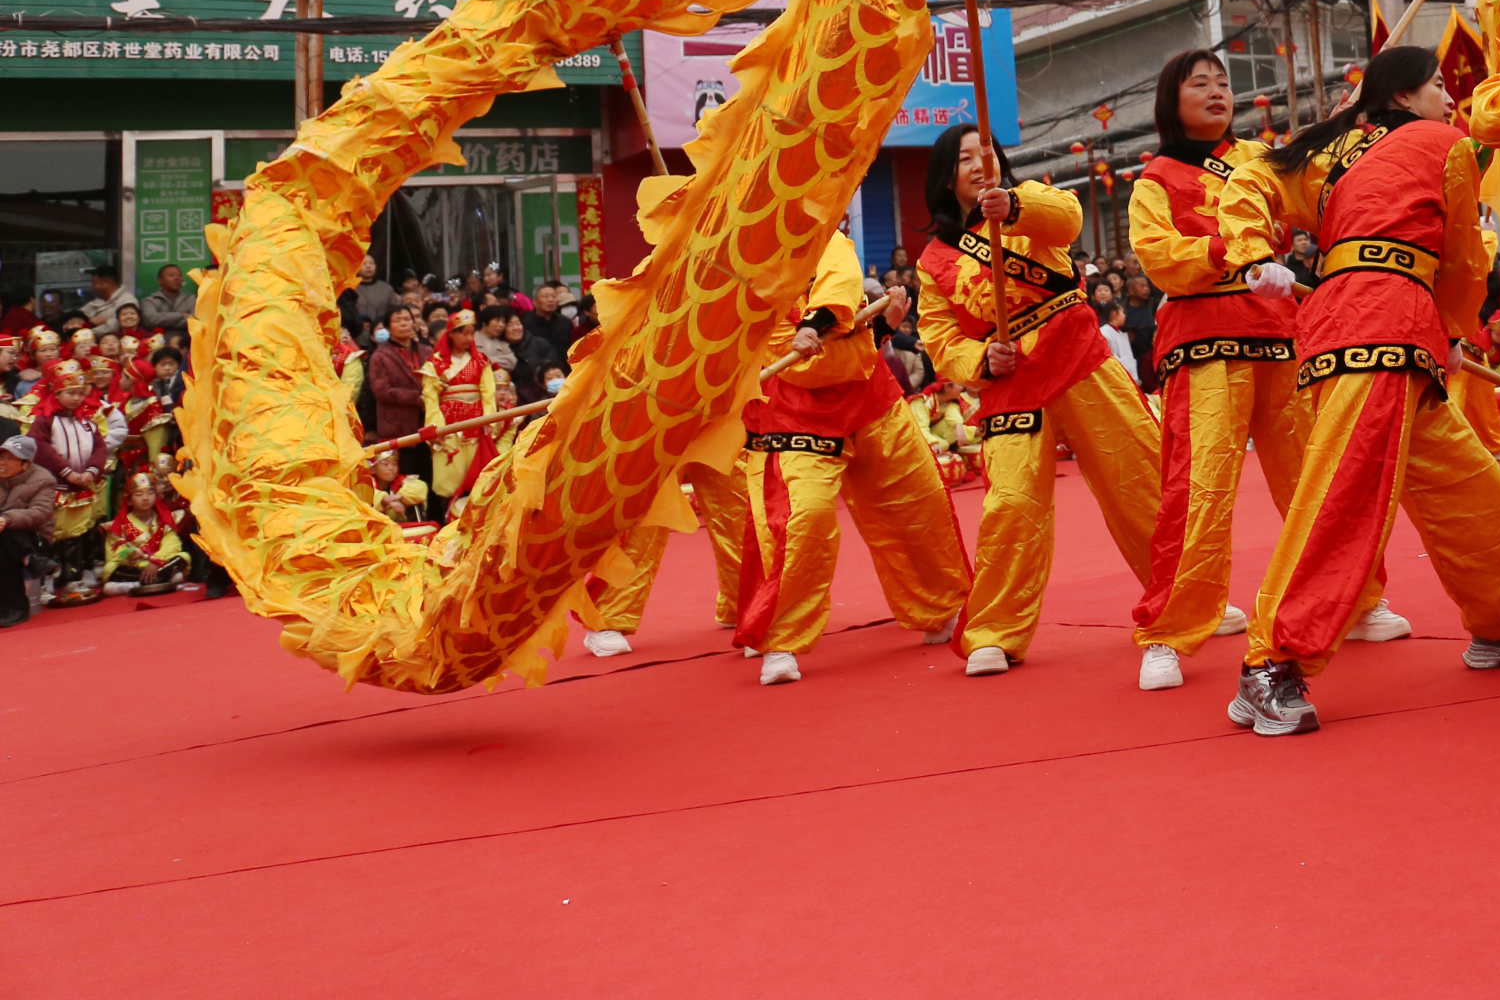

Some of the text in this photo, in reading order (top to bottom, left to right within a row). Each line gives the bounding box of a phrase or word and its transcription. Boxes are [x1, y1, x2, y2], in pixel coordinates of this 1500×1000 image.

[330, 46, 394, 63] 电话:15
[437, 142, 560, 173] 价药店
